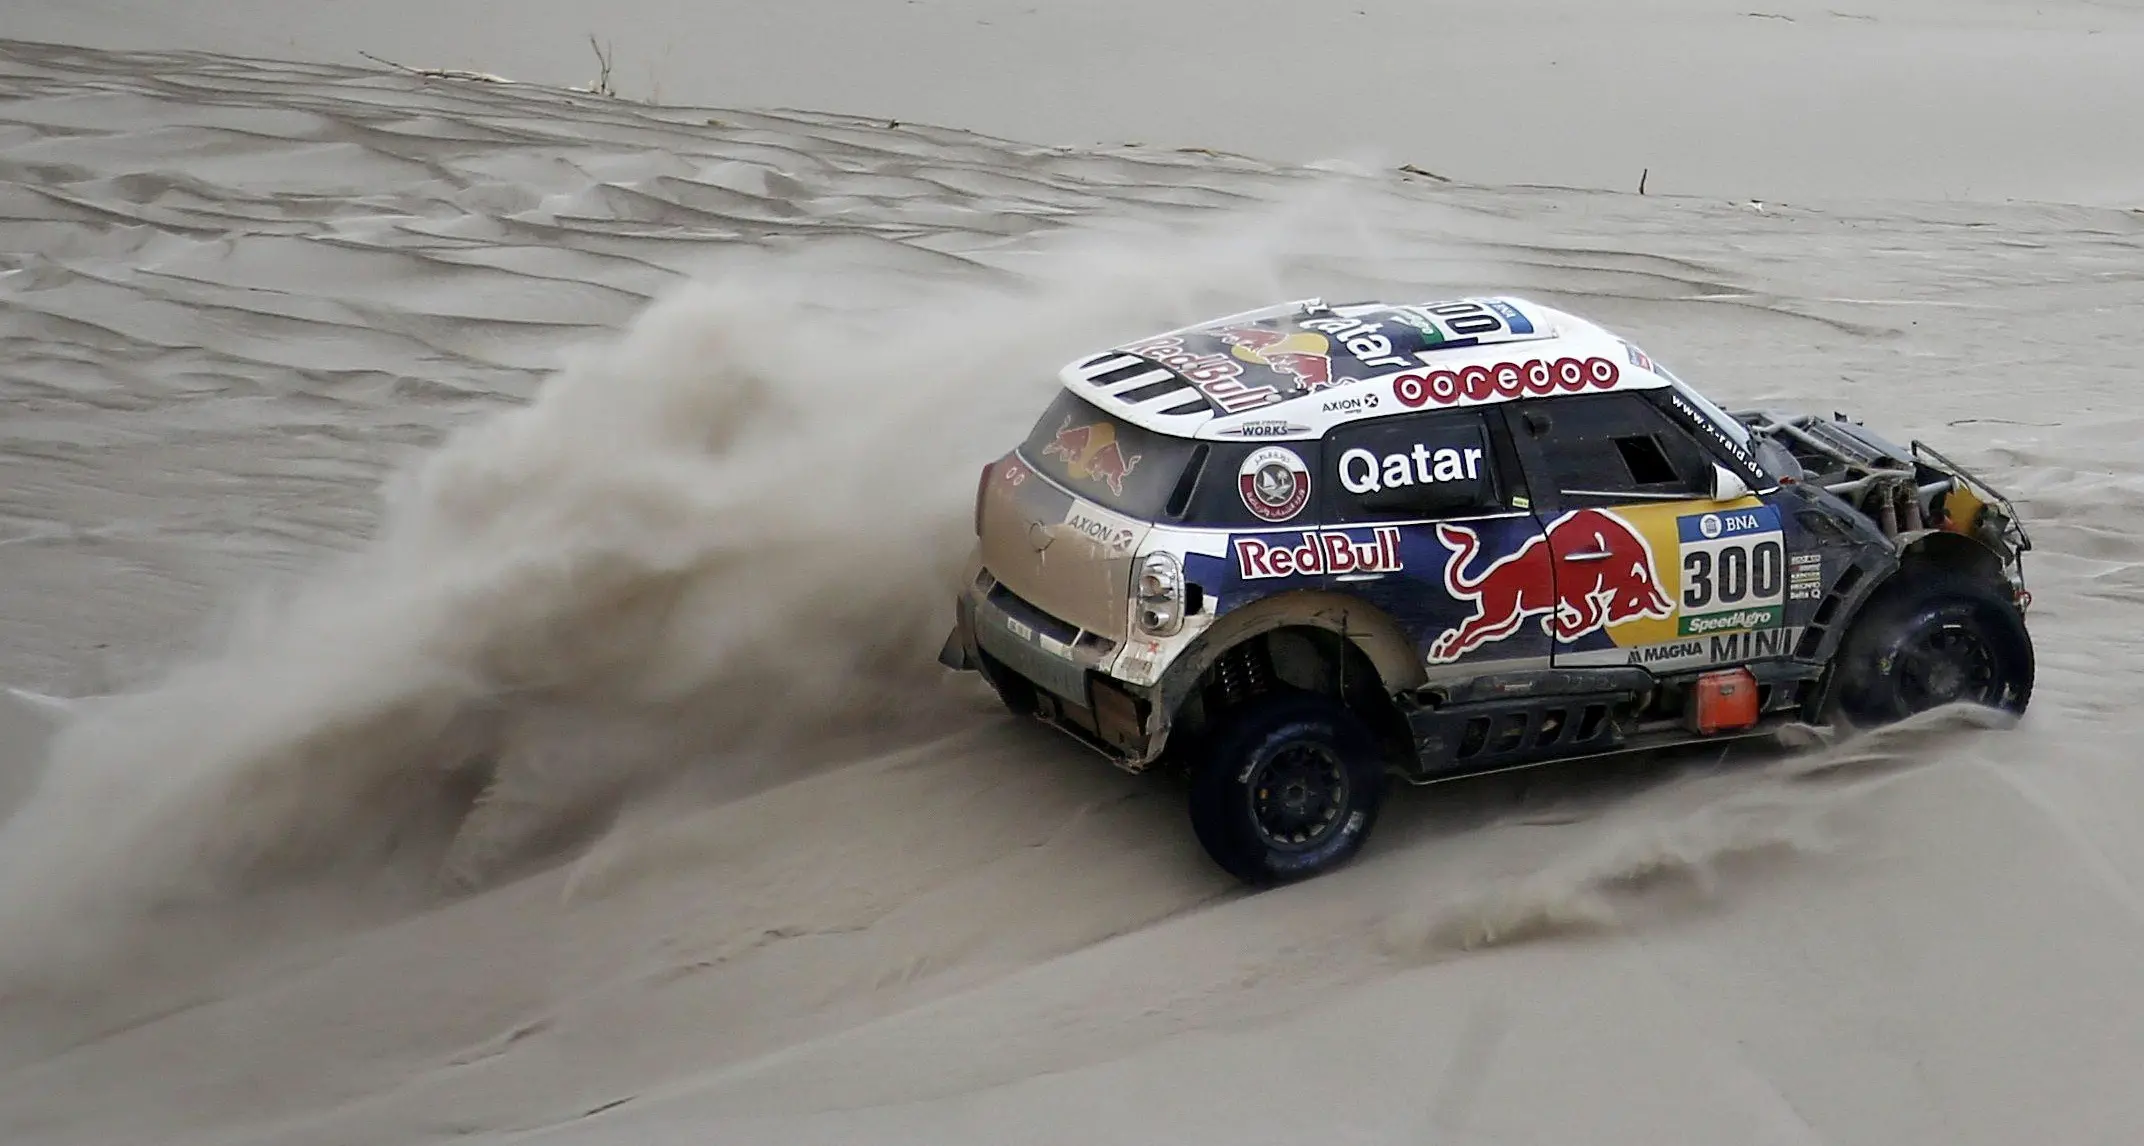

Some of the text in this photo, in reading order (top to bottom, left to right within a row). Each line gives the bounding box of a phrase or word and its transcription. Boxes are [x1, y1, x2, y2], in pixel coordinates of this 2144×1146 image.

[1421, 300, 1502, 335] 00
[1299, 318, 1412, 367] atar
[1396, 358, 1616, 403] ooredoo
[1322, 398, 1361, 413] AXION
[1242, 425, 1288, 437] WORKS
[1338, 443, 1482, 494] Qatar
[1068, 514, 1113, 541] AXION
[1726, 514, 1759, 532] BNA
[1683, 540, 1781, 609] 300
[1689, 611, 1771, 633] SpeedAgro
[1644, 627, 1792, 664] MAGNA MINI
